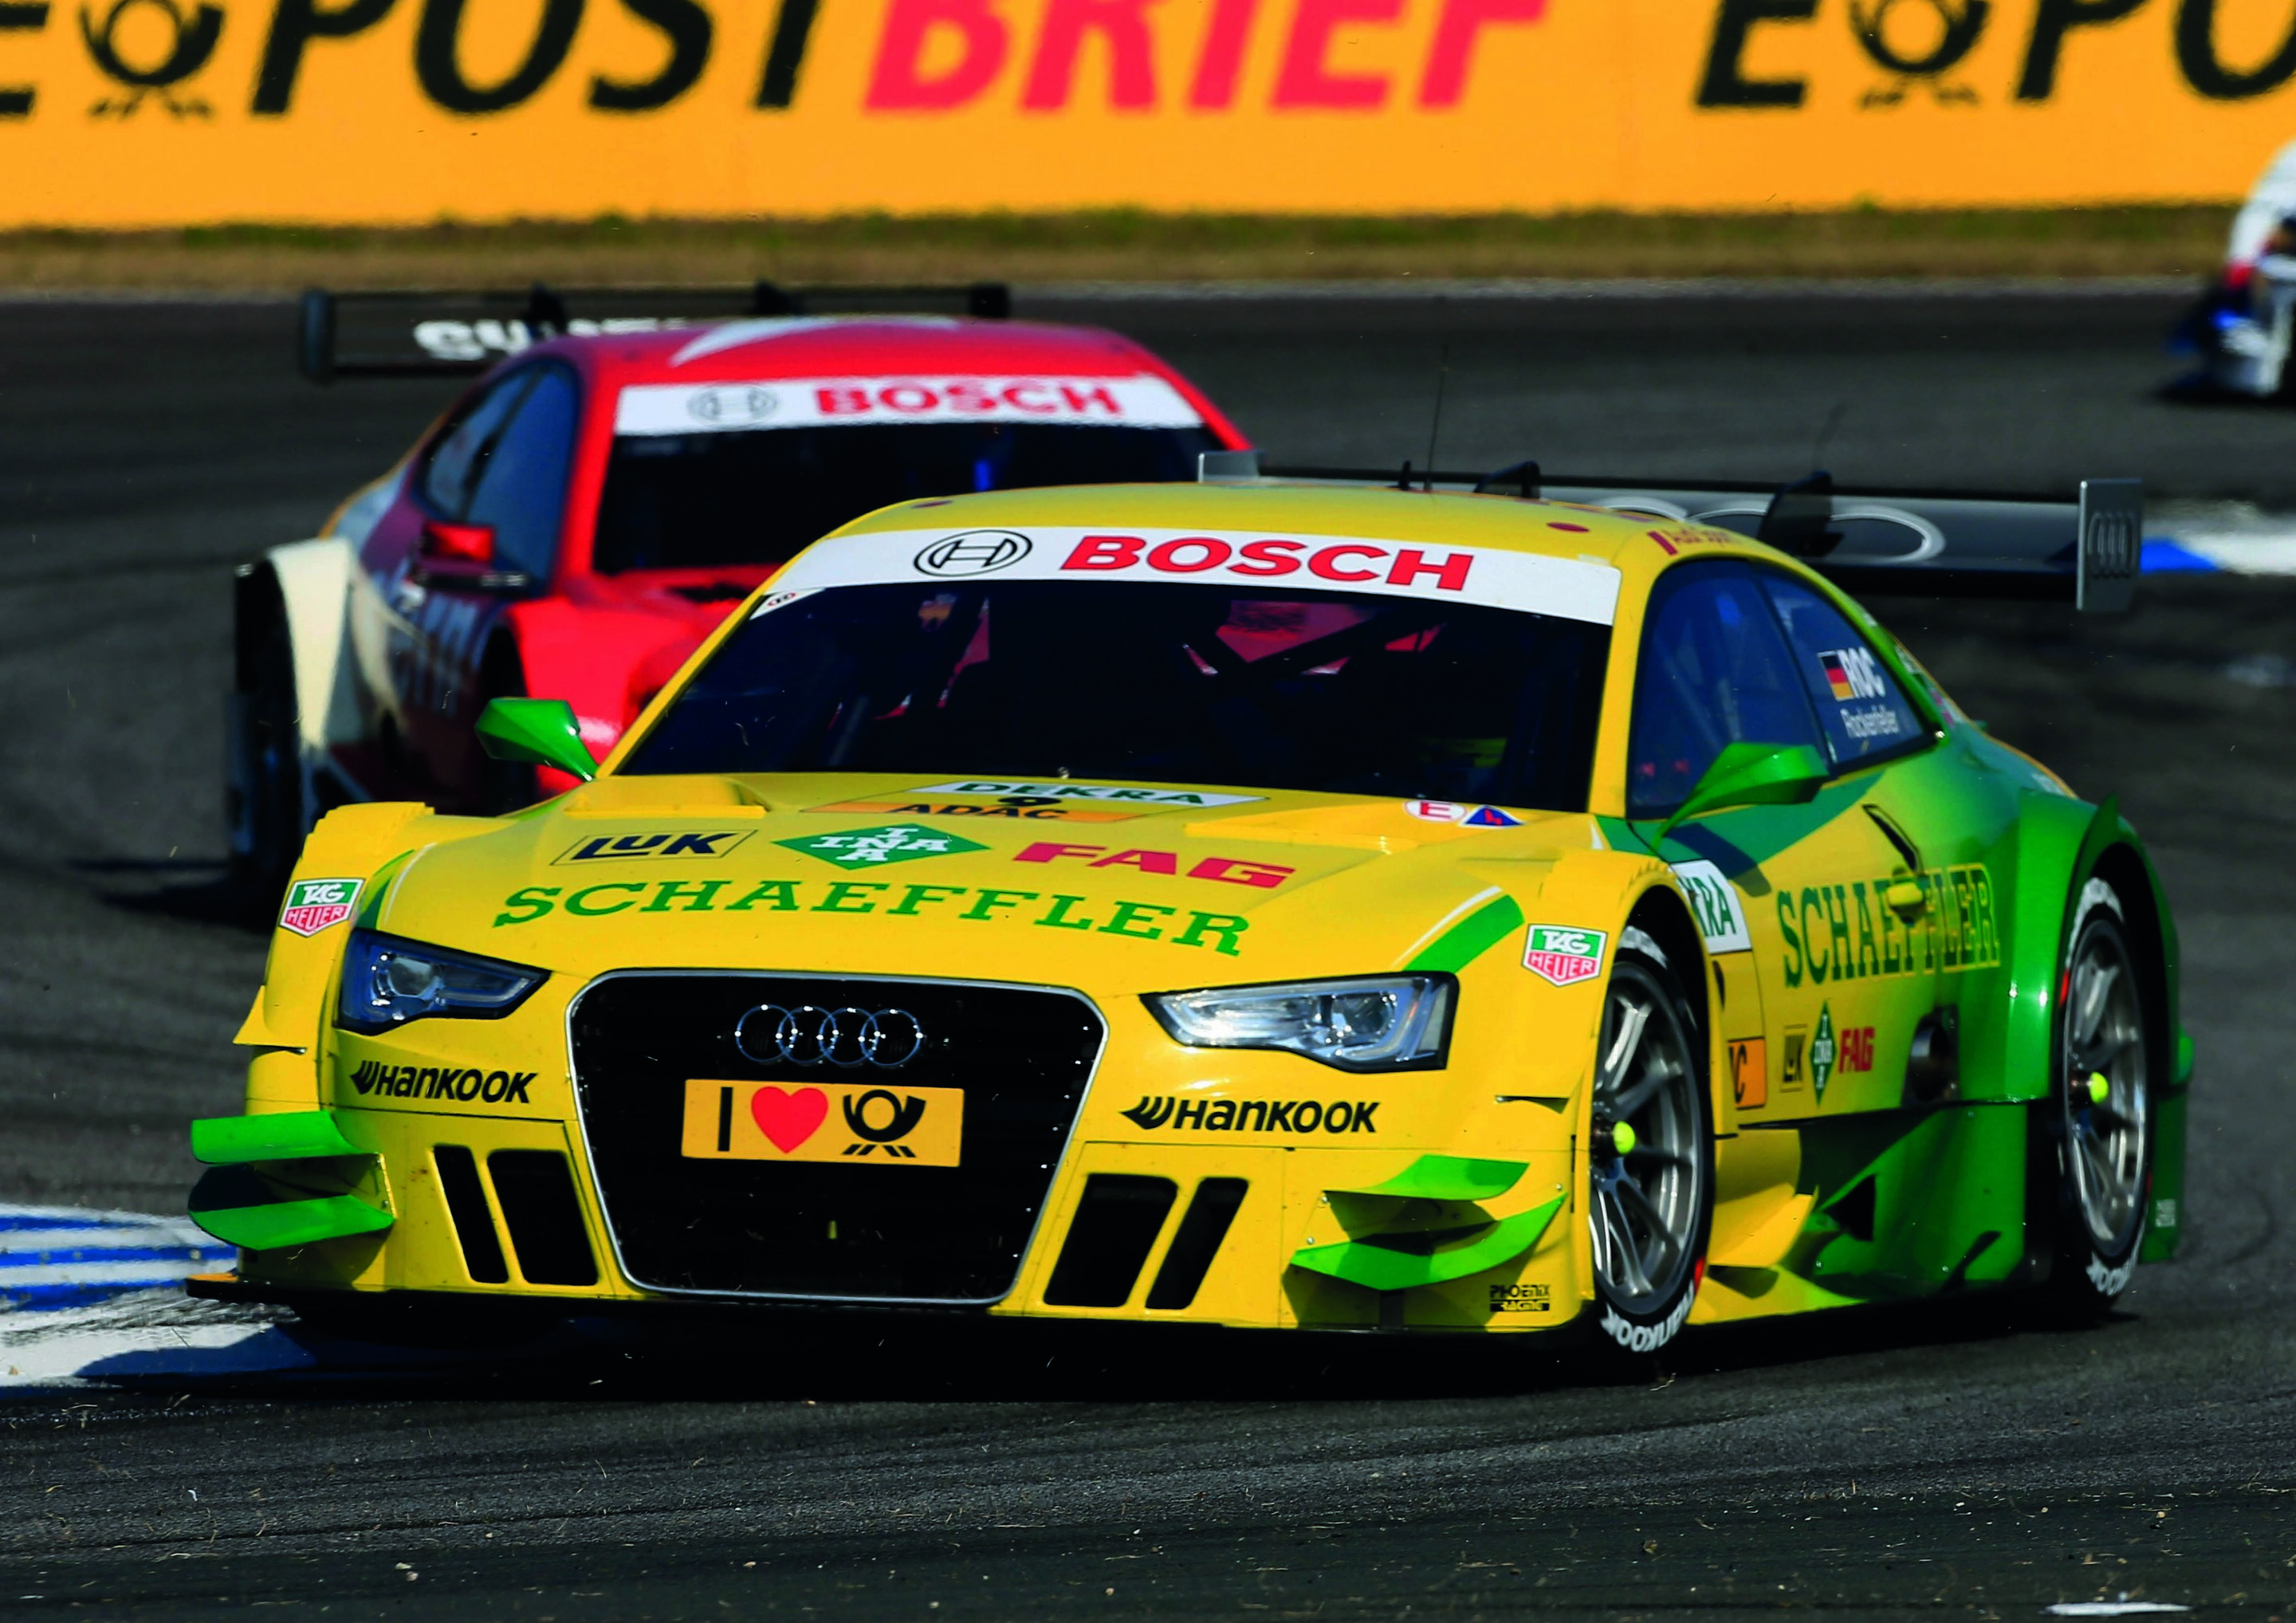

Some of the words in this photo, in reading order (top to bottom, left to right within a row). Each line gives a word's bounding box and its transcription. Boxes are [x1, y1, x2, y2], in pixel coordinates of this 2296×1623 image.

[814, 378, 1125, 416] BOSCH
[1060, 535, 1475, 592] BOSCH
[1836, 646, 1885, 699] ROC
[885, 804, 1068, 820] ADAC
[954, 782, 1205, 805] DEKRA
[1012, 841, 1296, 889] FAG
[302, 884, 346, 905] TAG
[286, 906, 344, 931] HEUER
[492, 880, 1250, 957] SCHAEFFLER
[1541, 930, 1591, 955] TAG
[1530, 953, 1594, 980] HEUER
[1838, 1026, 1875, 1075] FAG
[718, 1087, 733, 1152] I
